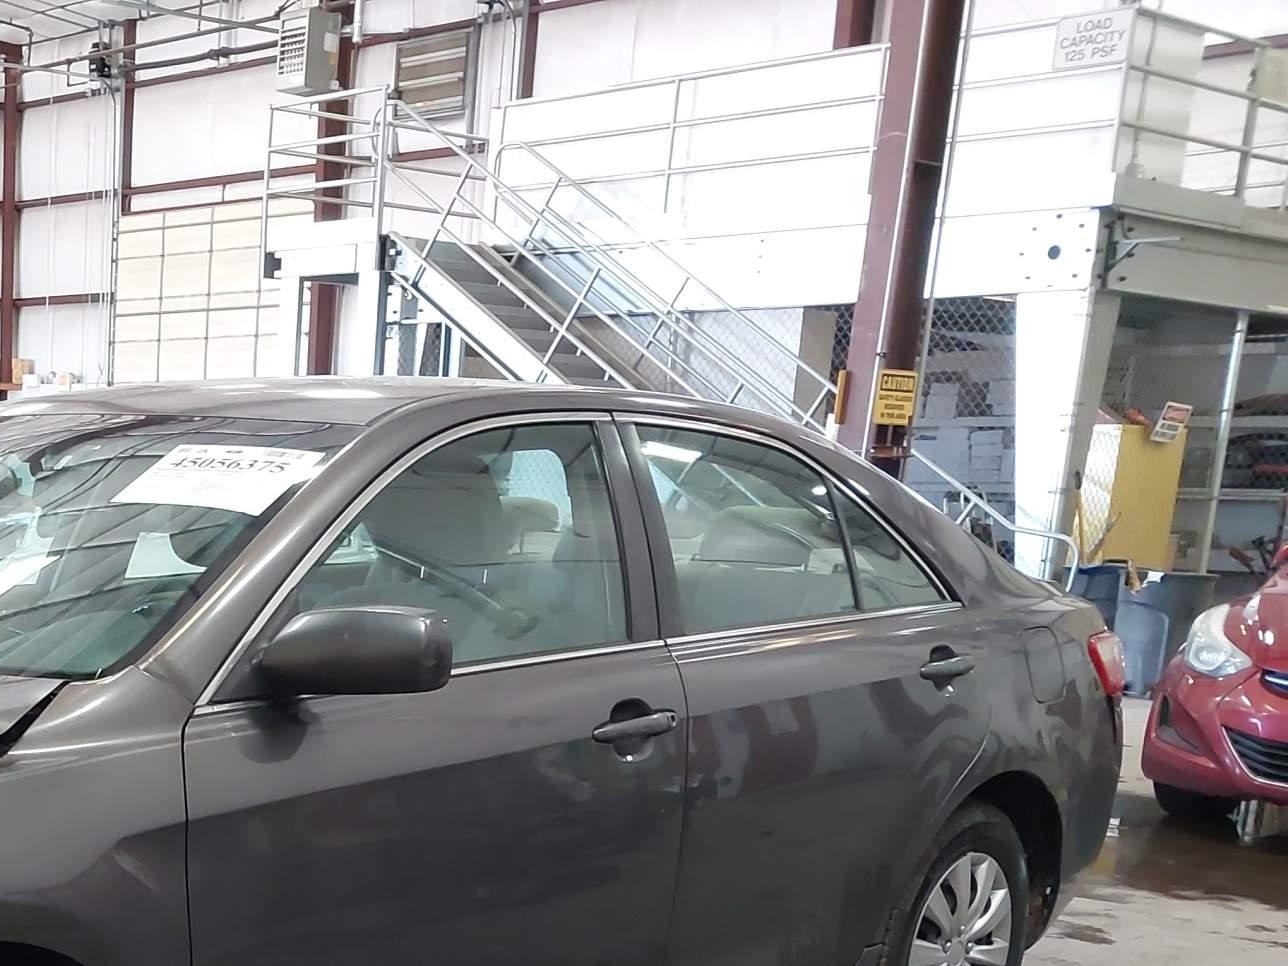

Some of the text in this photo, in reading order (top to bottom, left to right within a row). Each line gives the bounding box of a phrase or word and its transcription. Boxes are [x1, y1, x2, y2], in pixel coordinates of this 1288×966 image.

[1076, 17, 1113, 34] LOAD
[1059, 29, 1127, 50] CAPACITY
[1064, 44, 1118, 63] 125 PSF
[169, 457, 291, 473] 45056375
